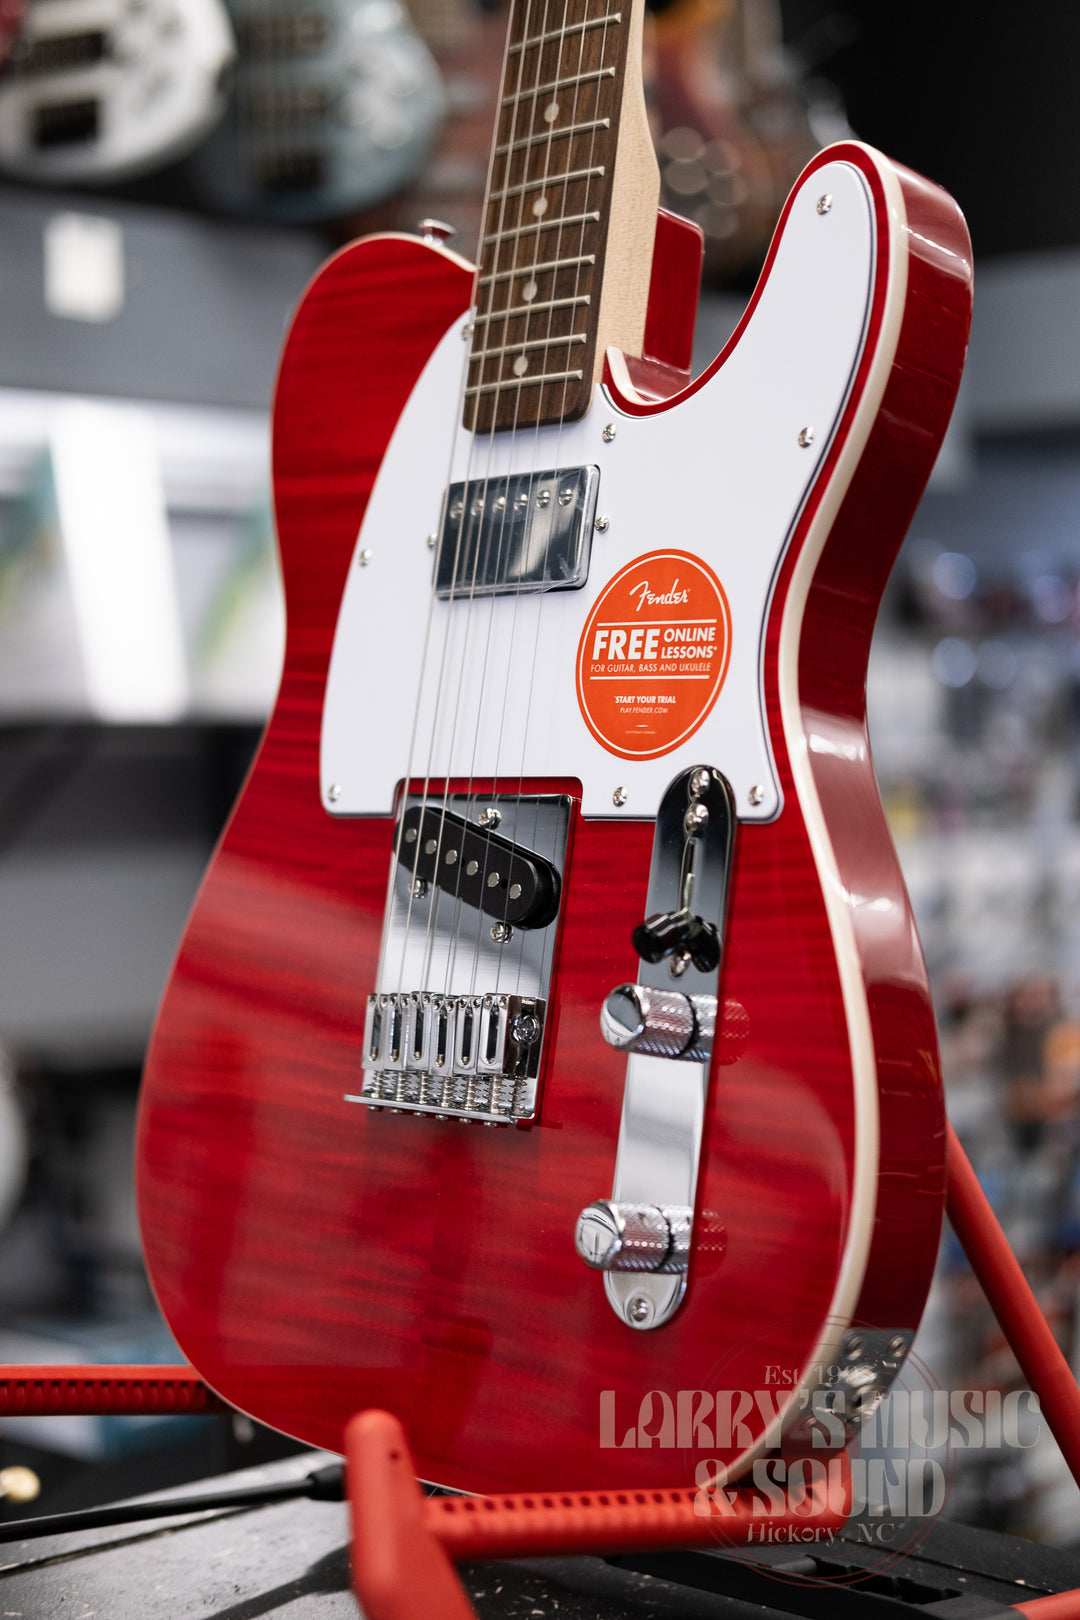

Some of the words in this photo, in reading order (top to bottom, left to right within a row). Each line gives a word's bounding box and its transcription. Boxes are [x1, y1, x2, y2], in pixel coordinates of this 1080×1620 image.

[629, 578, 689, 612] Fender
[592, 628, 661, 661] FREE
[663, 627, 716, 643] ONLINE
[590, 664, 605, 673] FOR
[607, 663, 636, 673] GUITAR,
[638, 663, 658, 672] BASS
[659, 663, 678, 672] AND
[679, 662, 711, 672] UKULELE
[636, 695, 657, 704] YOUR
[657, 695, 677, 704] TRIAL
[619, 706, 669, 714] PLAY.FENDER.COM
